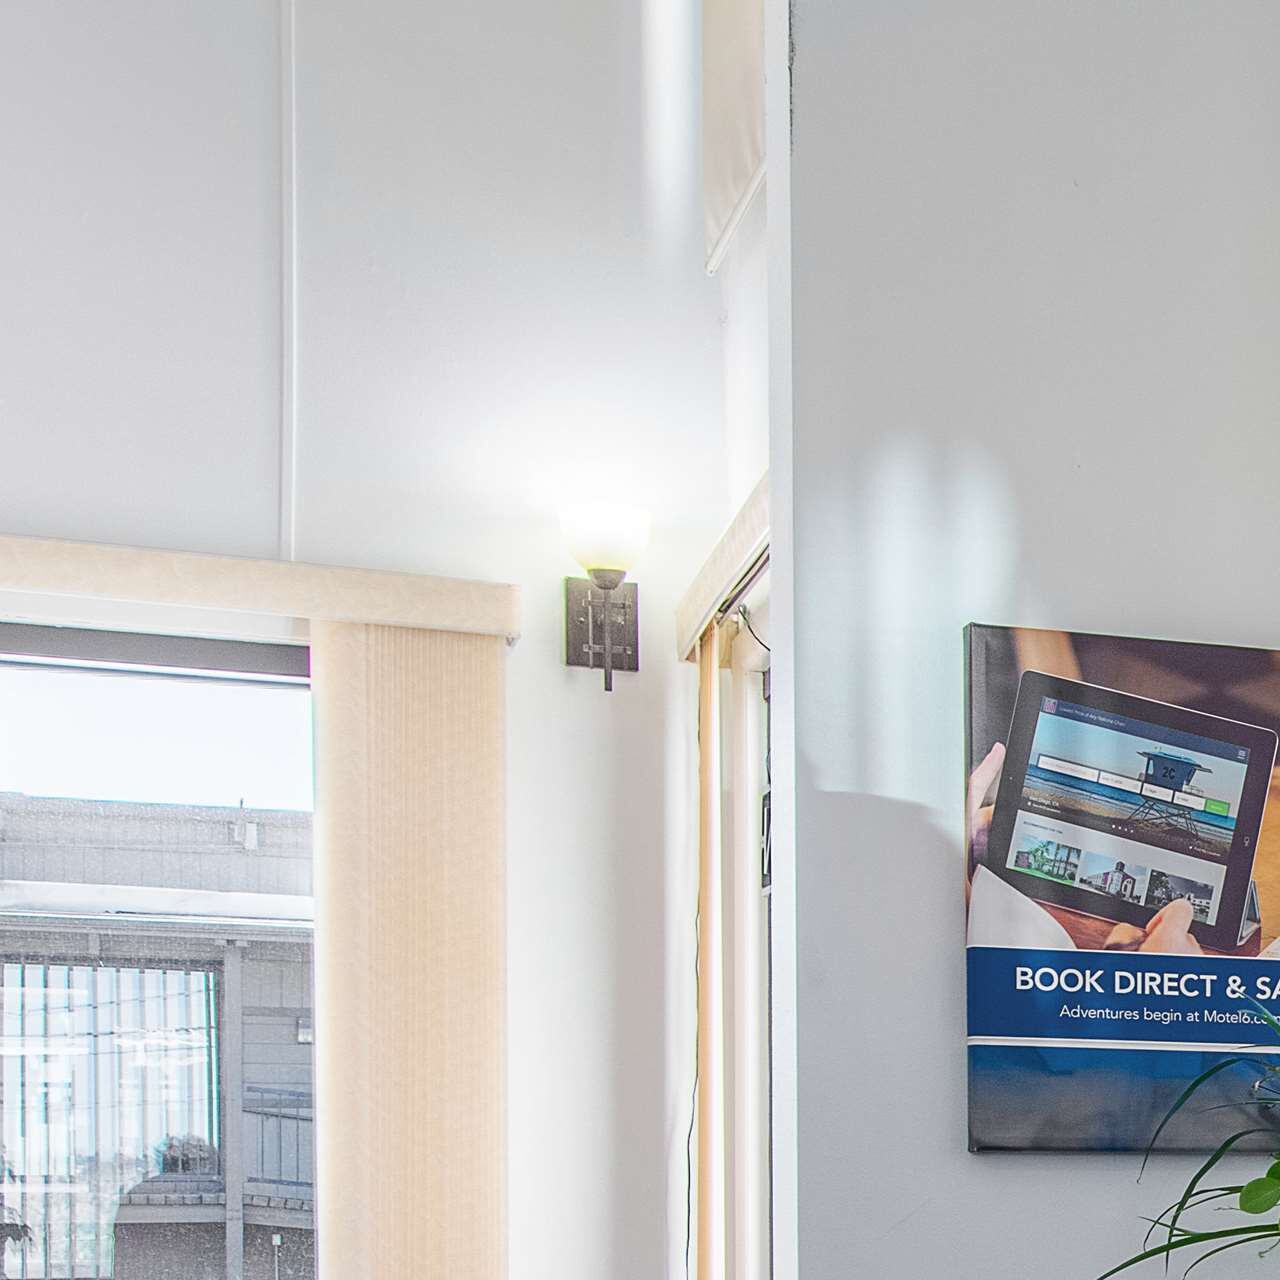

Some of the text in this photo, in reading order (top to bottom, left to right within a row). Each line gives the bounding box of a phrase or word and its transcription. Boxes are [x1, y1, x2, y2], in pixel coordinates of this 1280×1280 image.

[1162, 767, 1176, 779] 2C
[1015, 966, 1104, 993] BOOK
[1114, 971, 1217, 997] DIRECT
[1226, 975, 1247, 999] &
[1059, 1005, 1139, 1020] Adventures
[1143, 1007, 1182, 1024] begin
[1186, 1011, 1199, 1022] at
